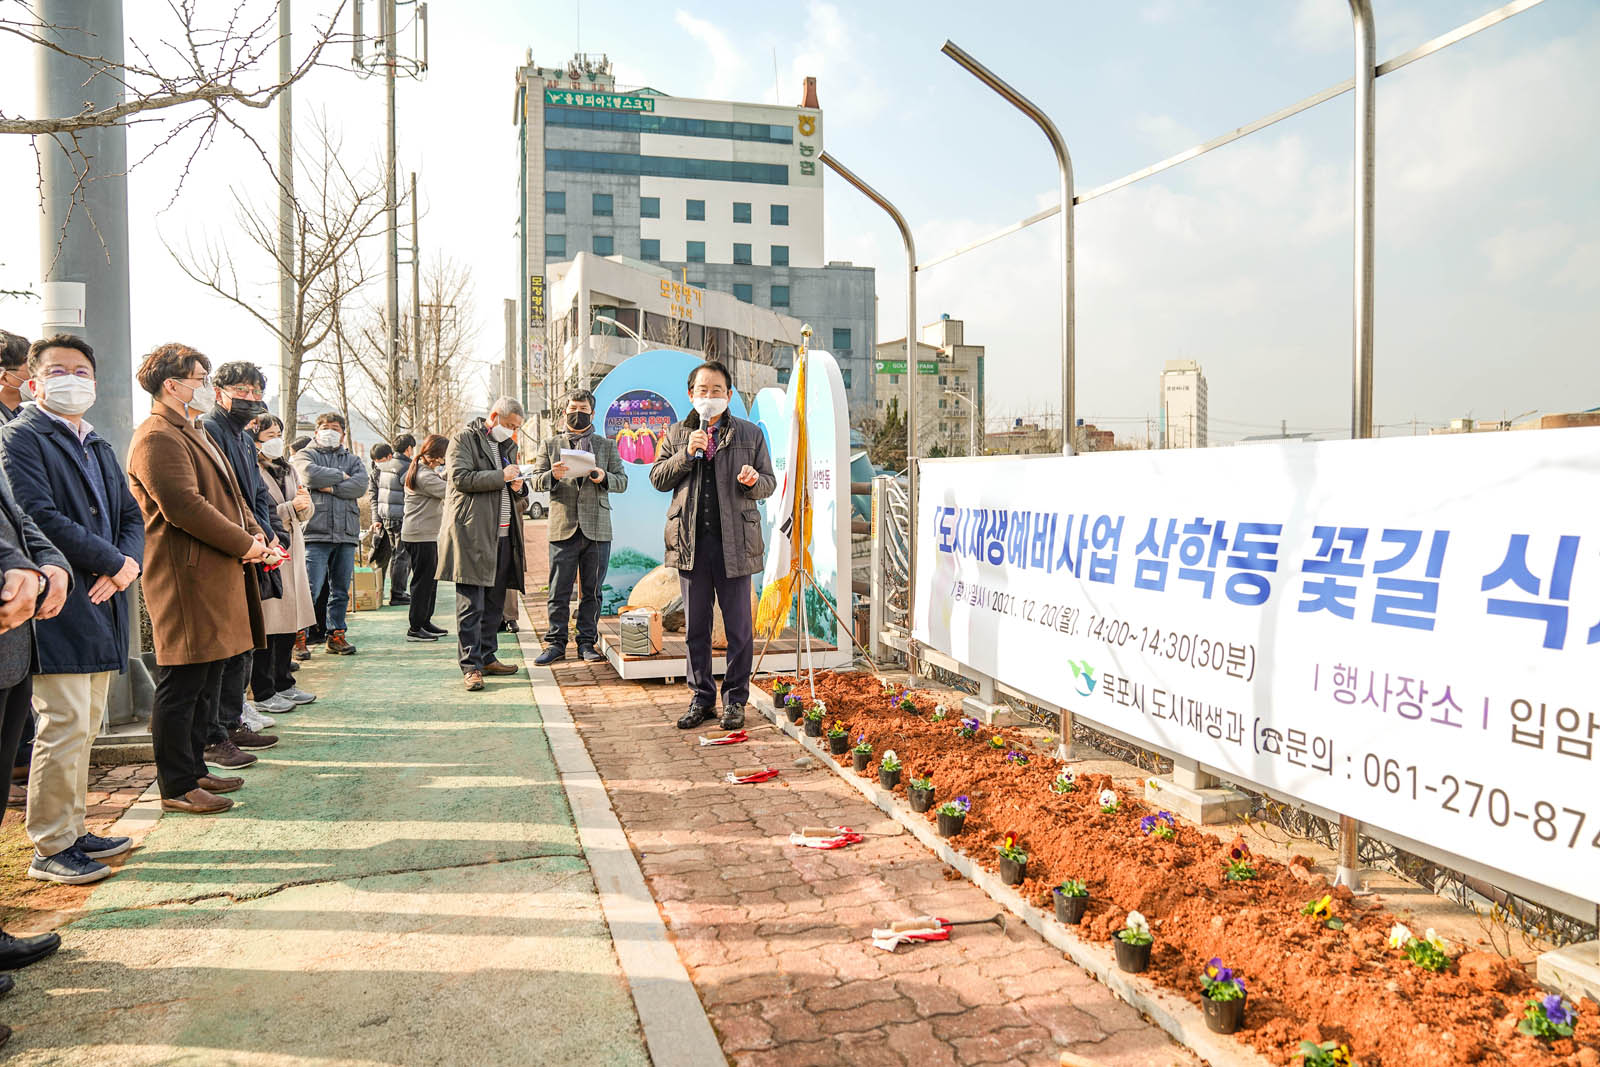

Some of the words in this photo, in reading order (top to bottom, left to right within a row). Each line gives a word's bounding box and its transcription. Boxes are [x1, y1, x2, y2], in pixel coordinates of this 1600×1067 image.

[800, 142, 816, 176] 농협
[813, 469, 831, 490] 삼학동
[1134, 517, 1283, 606] 삼학동
[1297, 525, 1450, 631] 꽃길
[1480, 533, 1600, 650] 식
[1087, 615, 1256, 682] 14:00~14:30(30분)
[1333, 662, 1463, 729] 행사장소
[1102, 672, 1145, 713] 목포시
[1151, 688, 1246, 746] 도시재생과
[1363, 752, 1600, 850] 061-270-87
